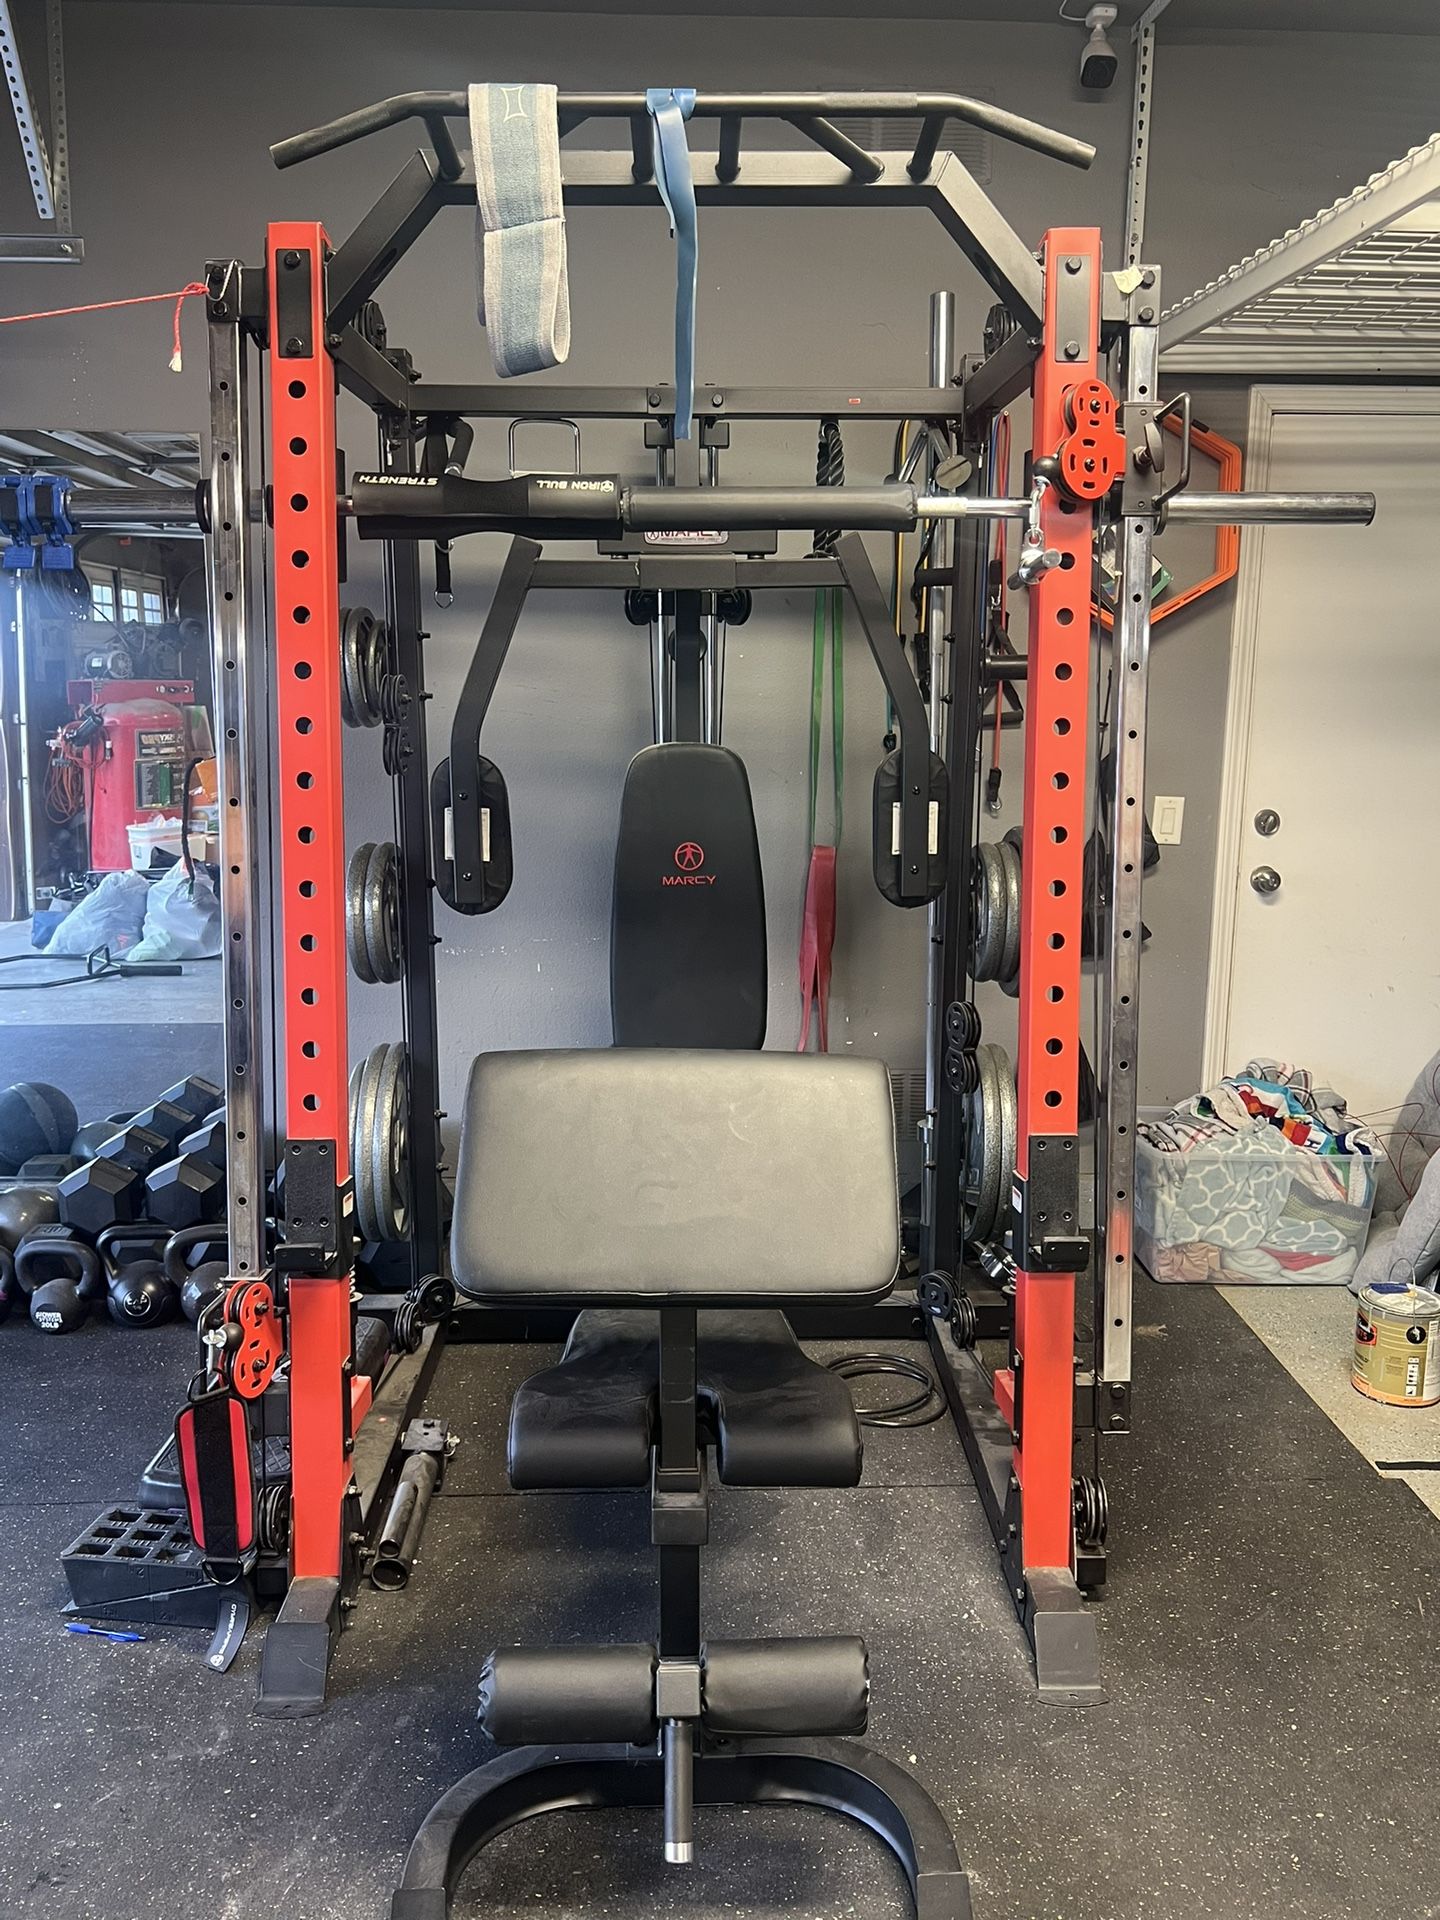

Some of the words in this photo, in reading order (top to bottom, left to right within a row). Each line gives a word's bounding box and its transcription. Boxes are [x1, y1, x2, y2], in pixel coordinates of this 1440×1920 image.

[359, 475, 438, 487] STRENGTH
[536, 480, 567, 489] BULL
[571, 481, 600, 490] IRON
[662, 875, 716, 885] MARCY
